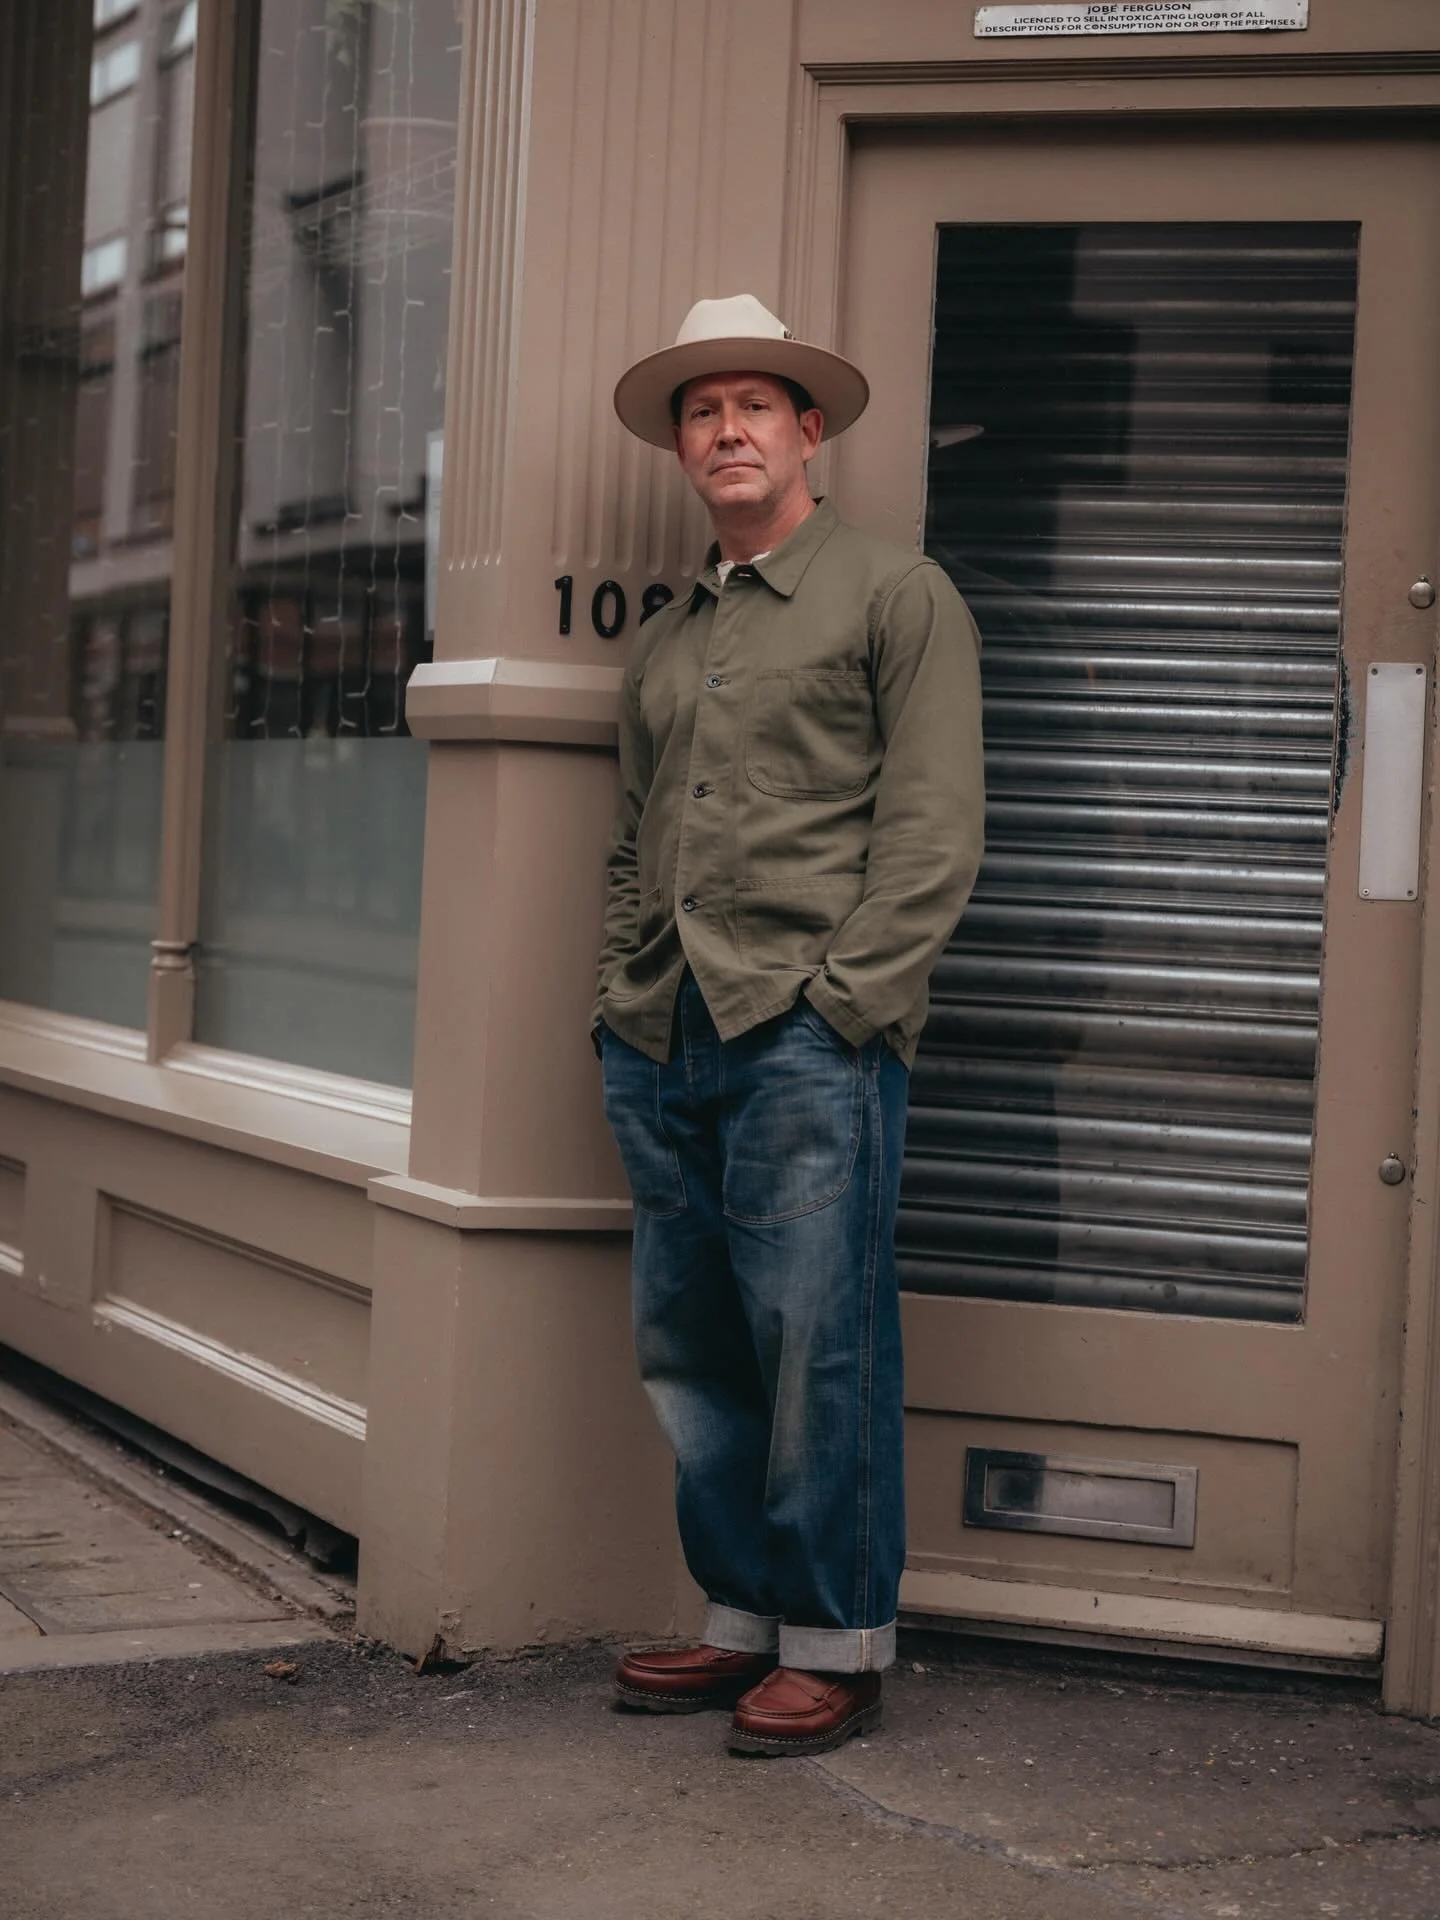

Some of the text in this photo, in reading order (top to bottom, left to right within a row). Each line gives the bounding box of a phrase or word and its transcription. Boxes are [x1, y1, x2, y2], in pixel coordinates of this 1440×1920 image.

[1123, 4, 1191, 12] FERGUSON
[1014, 16, 1064, 24] LICENCED
[1108, 14, 1186, 22] INTOXICATING
[985, 25, 1059, 33] DESCRIPTIONS
[1084, 22, 1163, 30] CONSUMPTION
[1201, 20, 1221, 28] OFF
